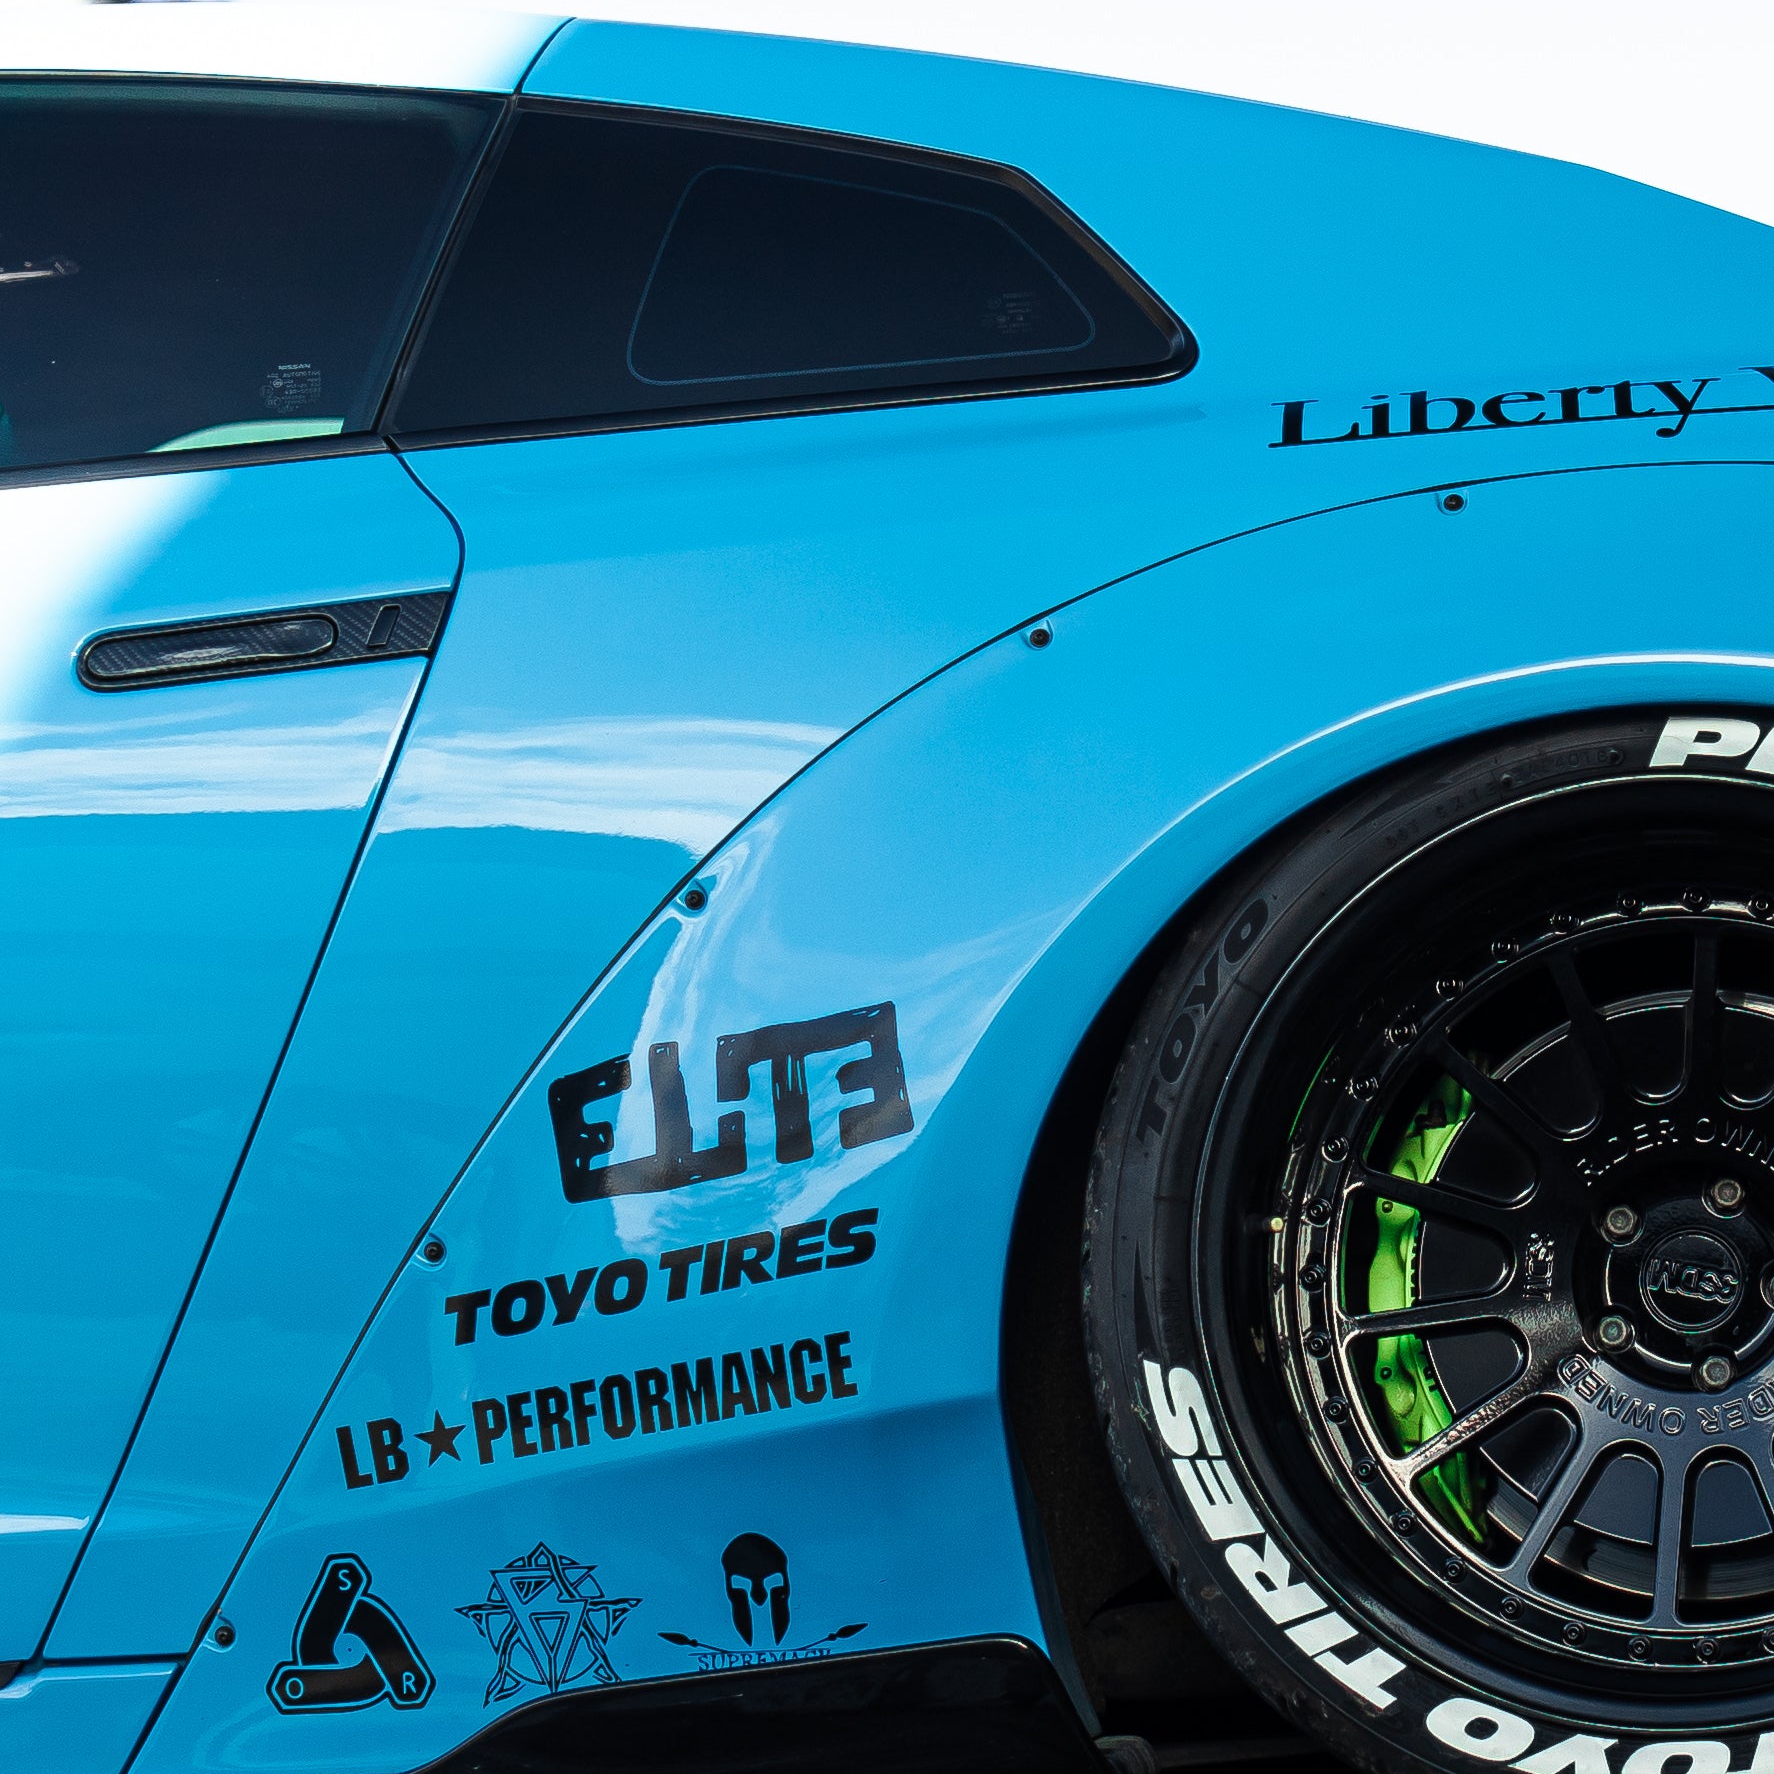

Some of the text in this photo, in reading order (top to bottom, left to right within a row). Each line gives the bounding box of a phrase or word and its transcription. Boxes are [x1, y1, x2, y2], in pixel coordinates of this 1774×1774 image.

[1268, 378, 1721, 447] Liberty
[1134, 898, 1270, 1142] TOYO
[547, 1000, 915, 1204] ELITE
[444, 1207, 879, 1347] TOYO TIRES
[335, 1330, 859, 1490] LB PERFORMANCE
[1556, 1352, 1686, 1436] OWNED
[338, 1569, 352, 1591] S
[1143, 1359, 1408, 1712] TIRES
[402, 1671, 417, 1695] R
[697, 1649, 832, 1671] SUPREM
